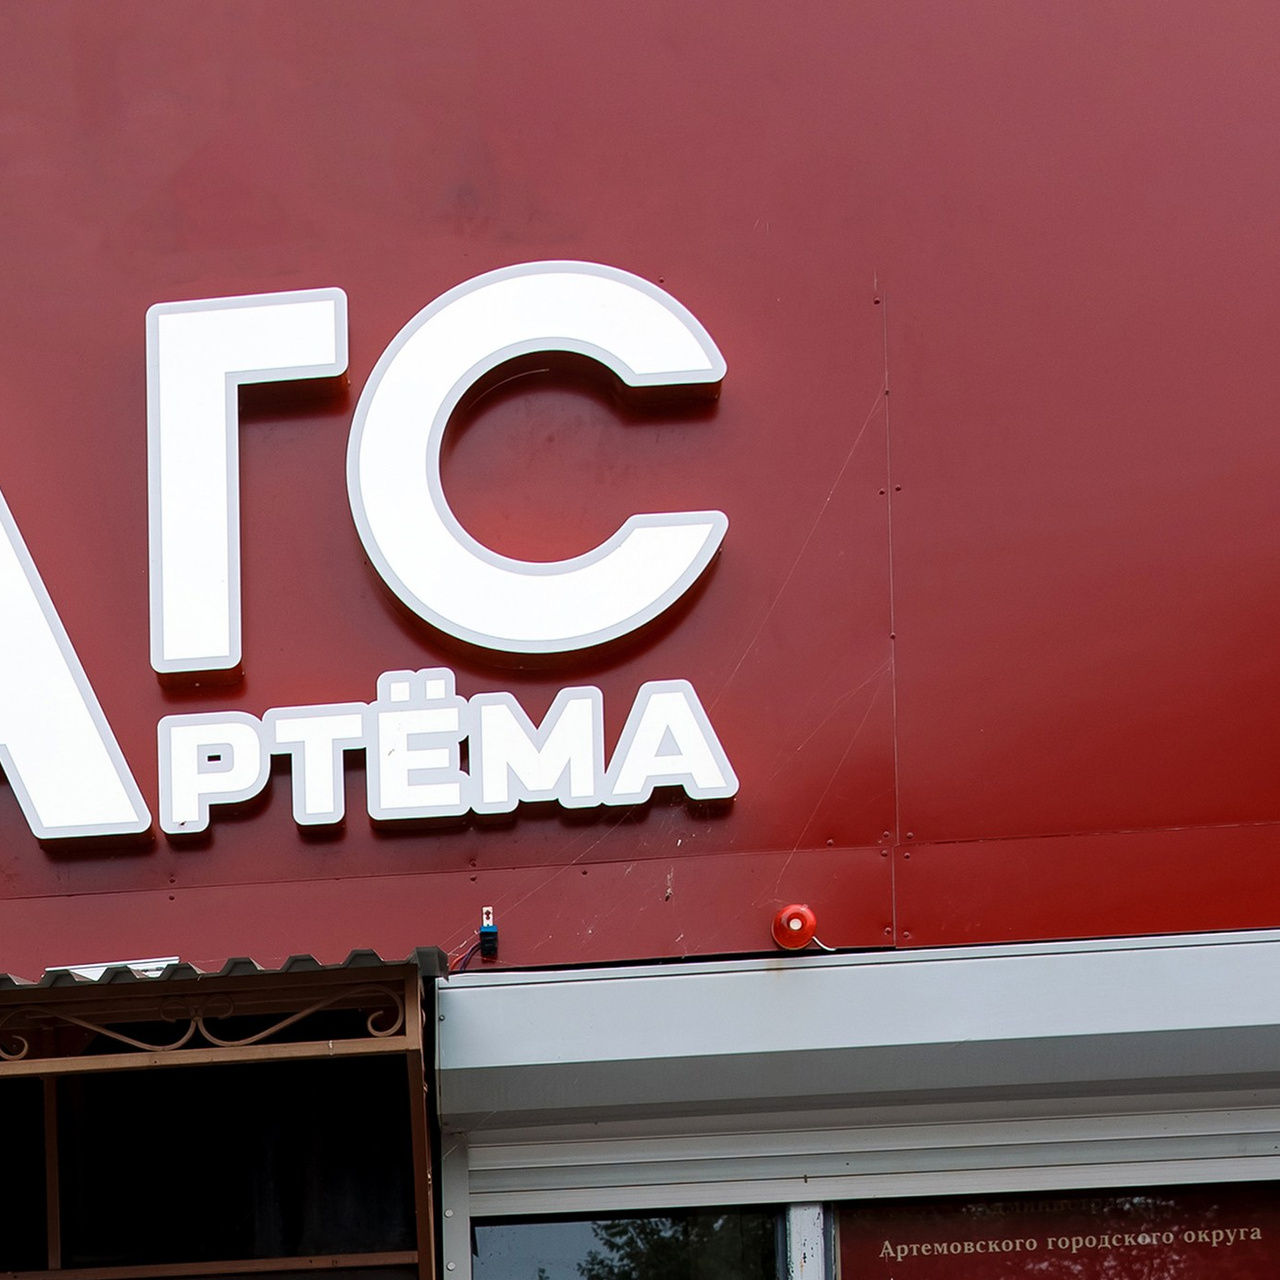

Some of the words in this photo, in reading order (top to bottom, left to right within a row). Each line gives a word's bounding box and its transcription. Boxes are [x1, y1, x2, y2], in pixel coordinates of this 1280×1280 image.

[879, 1236, 1037, 1260] Артемовского
[1047, 1229, 1174, 1252] городского
[1183, 1226, 1262, 1247] округа
